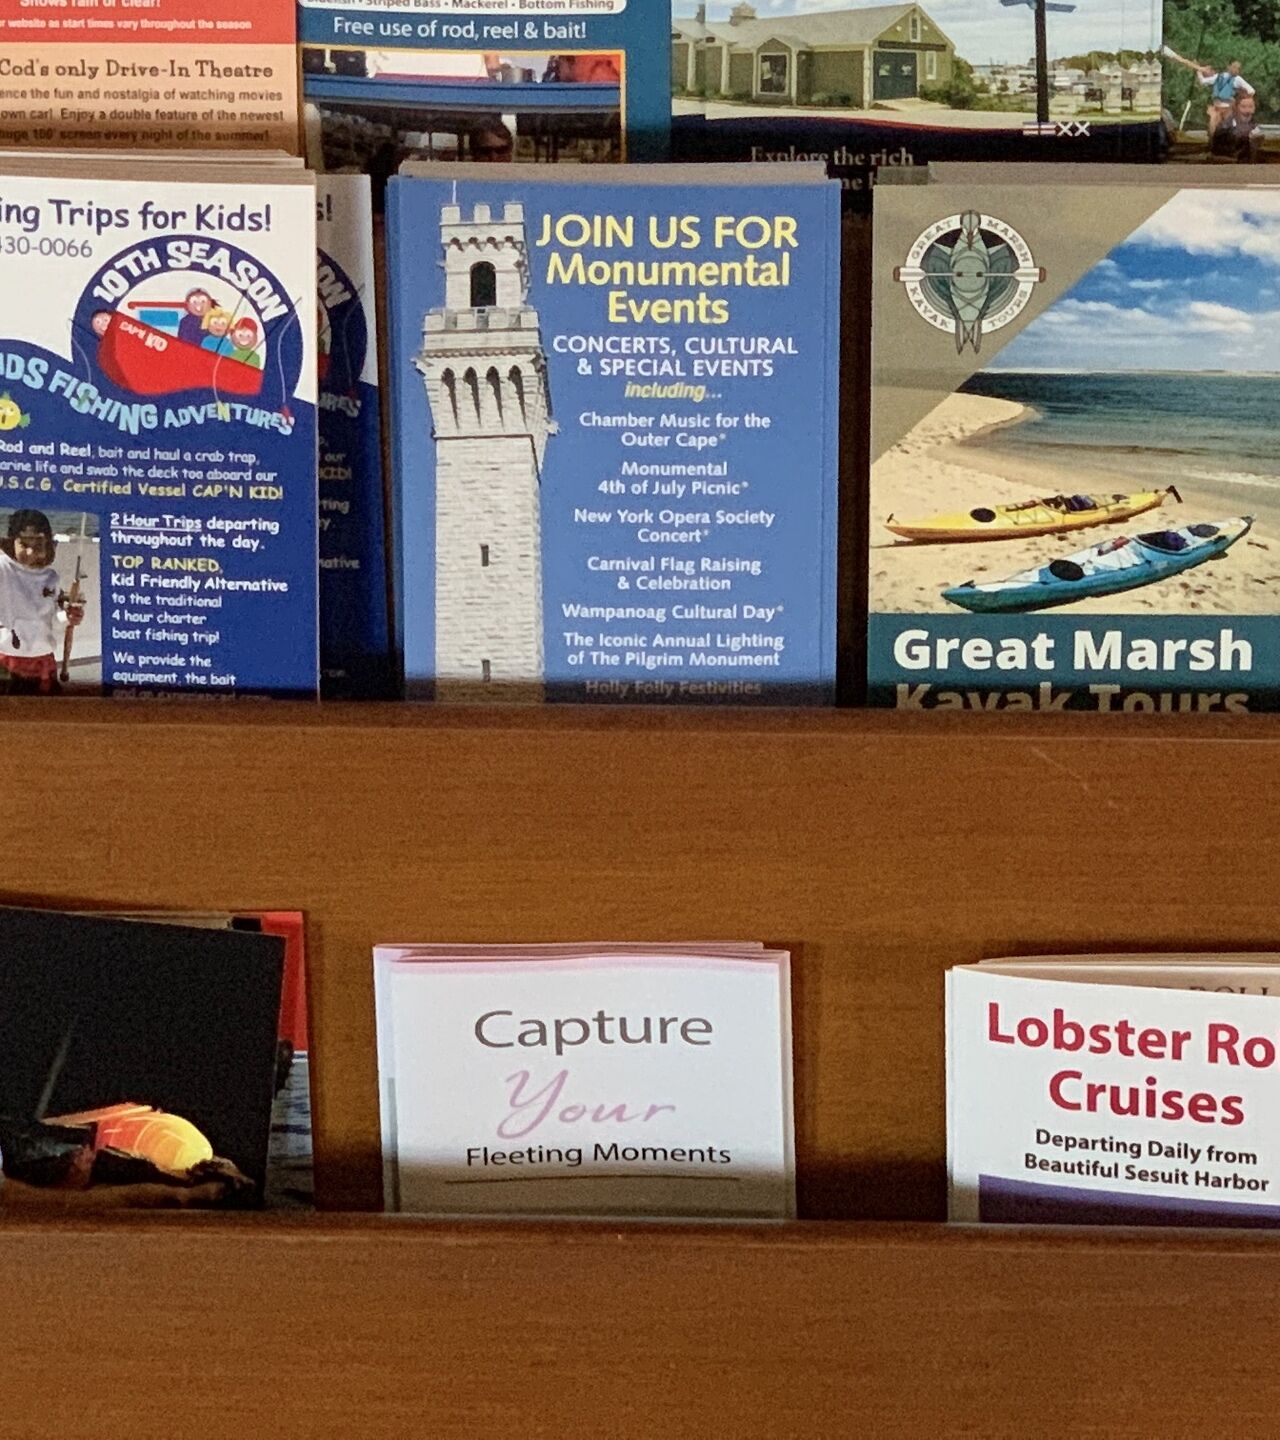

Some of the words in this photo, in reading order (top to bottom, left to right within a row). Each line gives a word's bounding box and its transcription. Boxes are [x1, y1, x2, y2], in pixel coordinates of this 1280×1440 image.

[333, 17, 375, 37] Free
[379, 23, 413, 37] use
[418, 20, 438, 37] of
[442, 21, 479, 40] rod,
[483, 21, 519, 39] reel
[524, 23, 539, 39] &
[543, 22, 587, 39] bait!
[48, 199, 131, 235] Trips
[137, 203, 187, 230] for
[194, 205, 272, 233] Kids!
[536, 214, 634, 248] JOIN
[649, 215, 699, 249] US
[714, 216, 799, 249] FOR
[546, 253, 790, 288] Monumental
[608, 291, 729, 325] Events
[893, 631, 1054, 671] Great
[1073, 629, 1253, 671] Marsh
[474, 1009, 713, 1056] Capture
[988, 1002, 1192, 1060] Lobster
[496, 1068, 676, 1139] Your
[1049, 1070, 1245, 1126] Cruises
[467, 1145, 582, 1167] Fleeting
[594, 1142, 731, 1164] Moments
